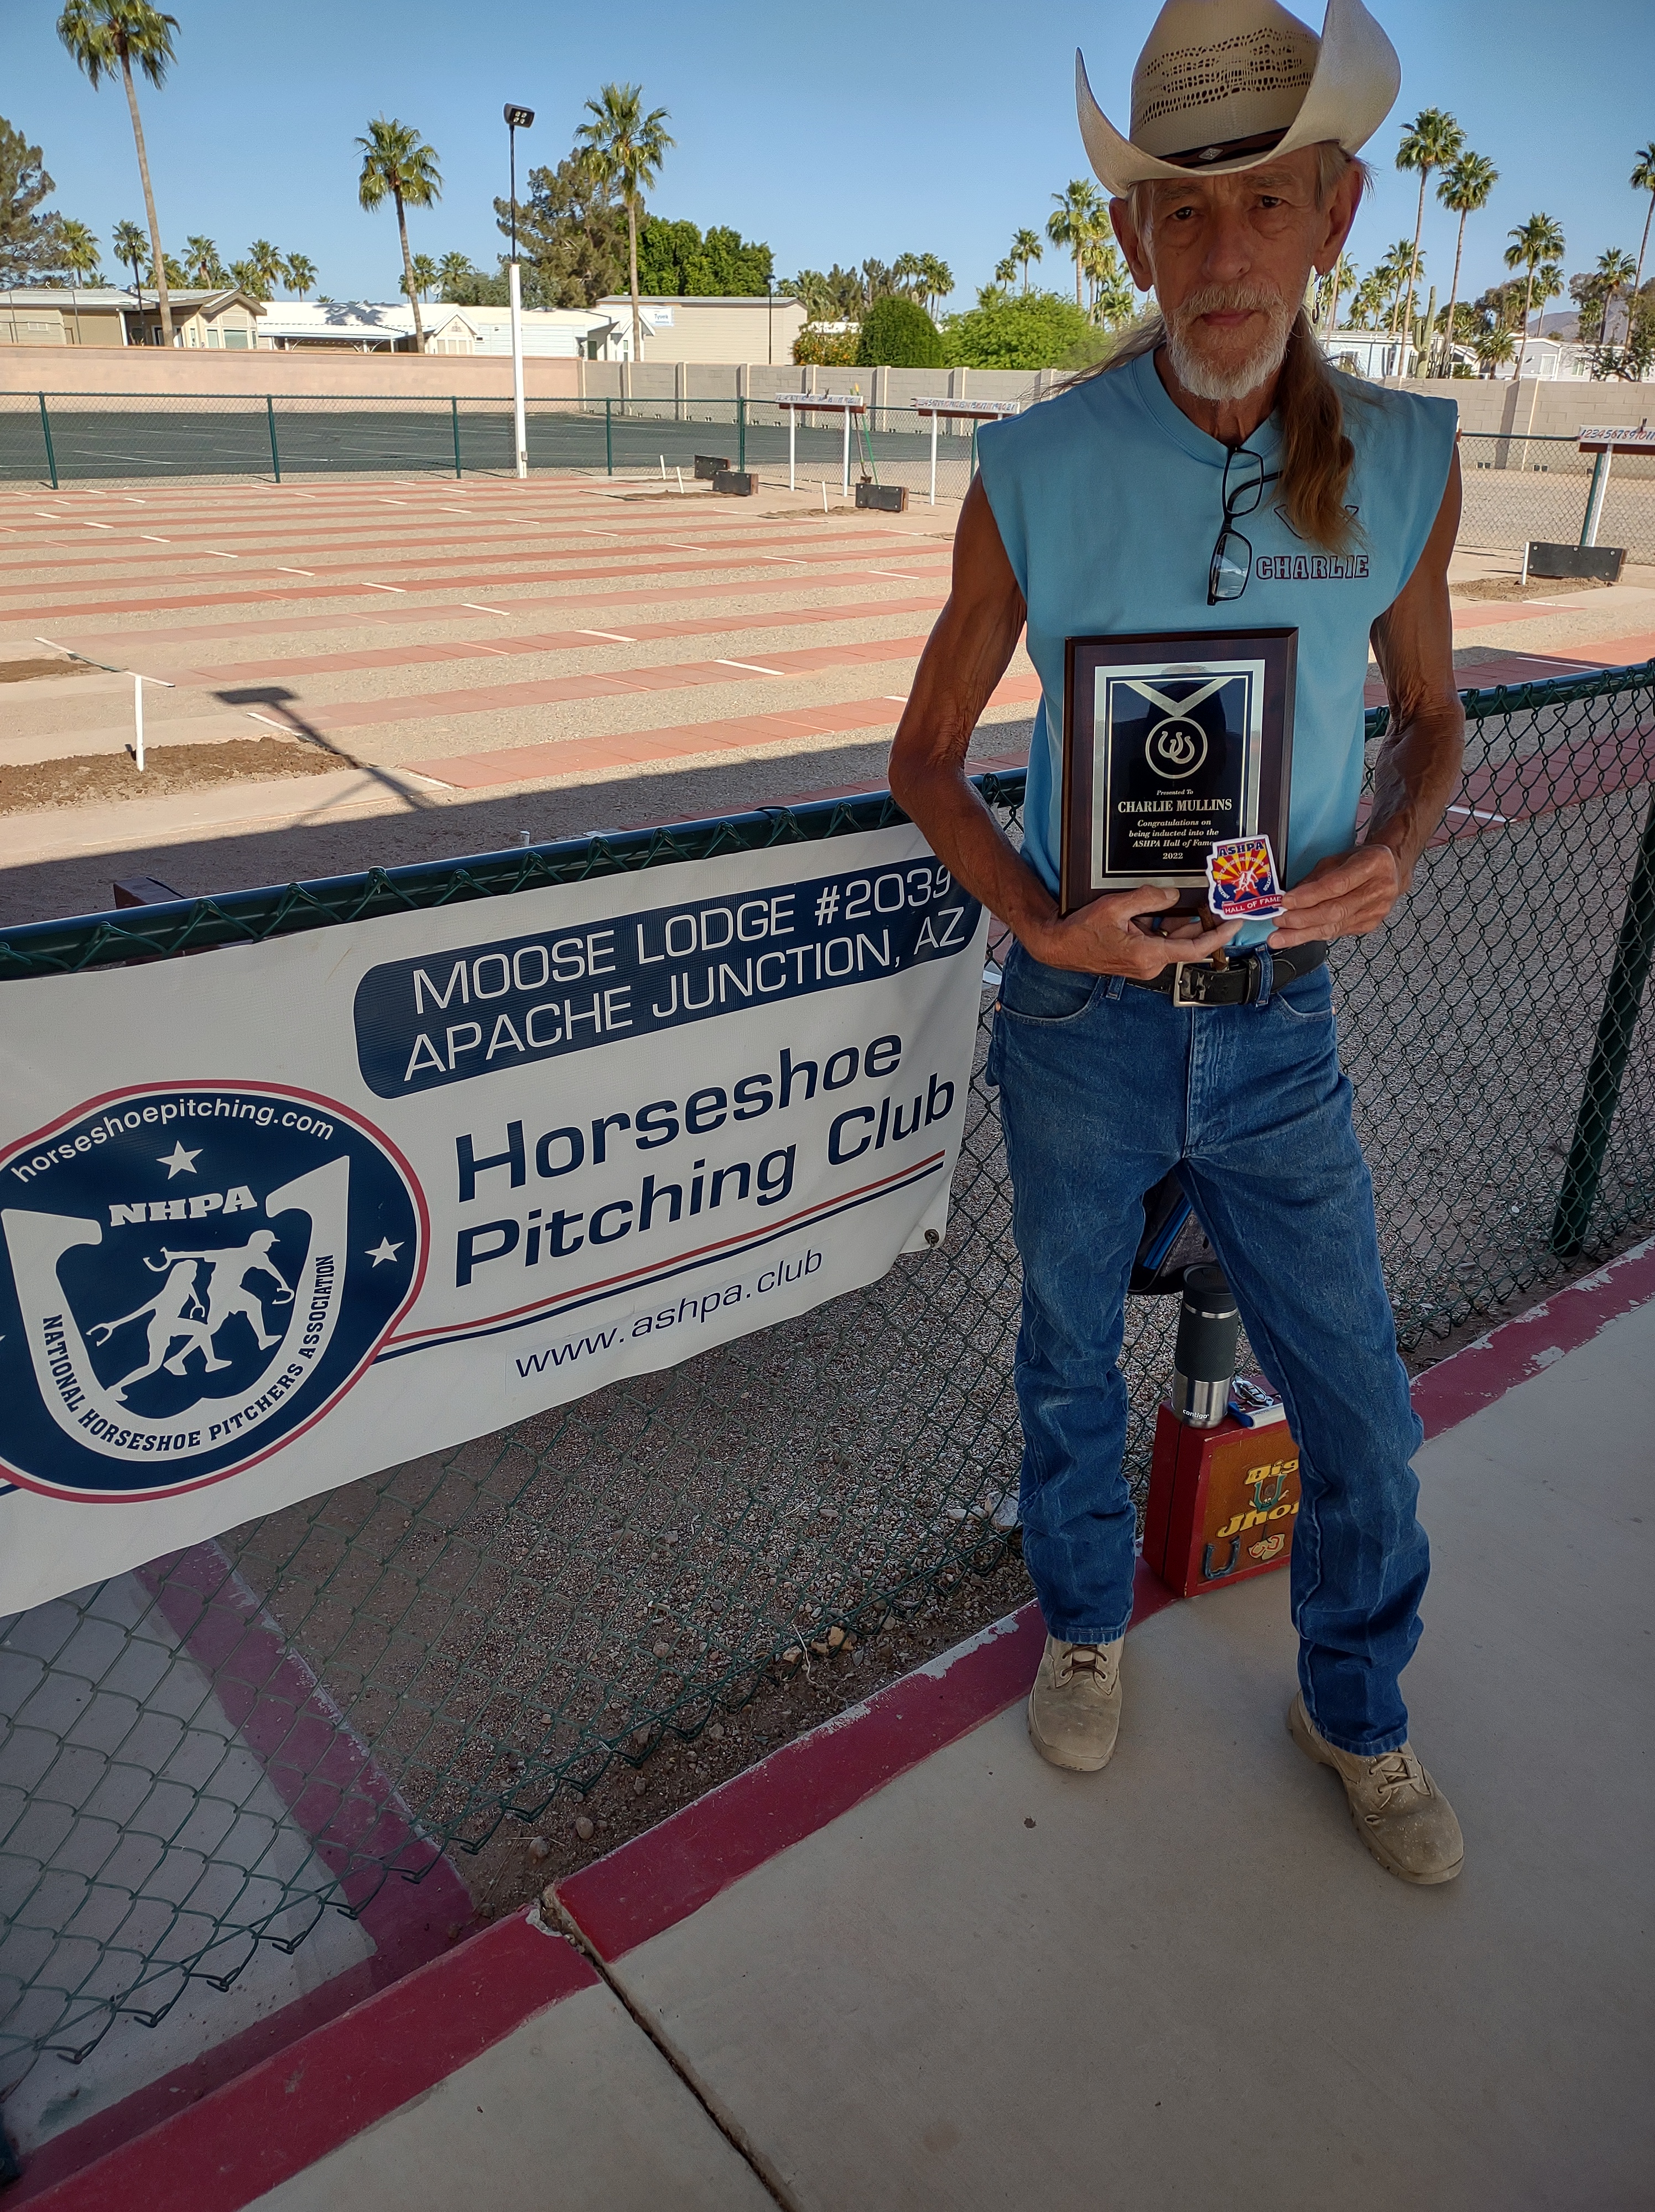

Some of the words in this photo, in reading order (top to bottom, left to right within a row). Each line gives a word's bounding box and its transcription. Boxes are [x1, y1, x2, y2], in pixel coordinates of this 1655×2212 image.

[1256, 555, 1369, 580] CHARLIE
[1118, 800, 1173, 813] CHARLIE
[1177, 799, 1232, 811] MULLINS
[1129, 830, 1150, 838] being
[1137, 819, 1199, 828] Congratulations
[1182, 839, 1191, 848] of
[1218, 841, 1264, 857] ASHPA
[1225, 905, 1245, 914] HALL
[1260, 896, 1282, 906] FAME
[412, 930, 615, 1014] MOOSE
[637, 894, 796, 965] LODGE
[814, 864, 951, 927] #2039
[404, 985, 633, 1082] APACHE
[652, 928, 901, 1019] JUNCTION,
[914, 906, 965, 955] AZ
[455, 1033, 903, 1203] Horseshoe
[11, 1098, 334, 1182] horseshoepitching.com
[455, 1143, 796, 1288] Pitching
[827, 1072, 955, 1166] Club
[109, 1185, 257, 1227] NHPA
[515, 1248, 823, 1379] www.ashpa.club
[43, 1314, 86, 1413] NATIONAL
[78, 1408, 201, 1452] HORSESHOE
[209, 1363, 304, 1441] PITCHERS
[298, 1255, 334, 1359] ASSOCIATION
[1183, 1409, 1208, 1419] contigo
[1245, 1459, 1298, 1485] Big
